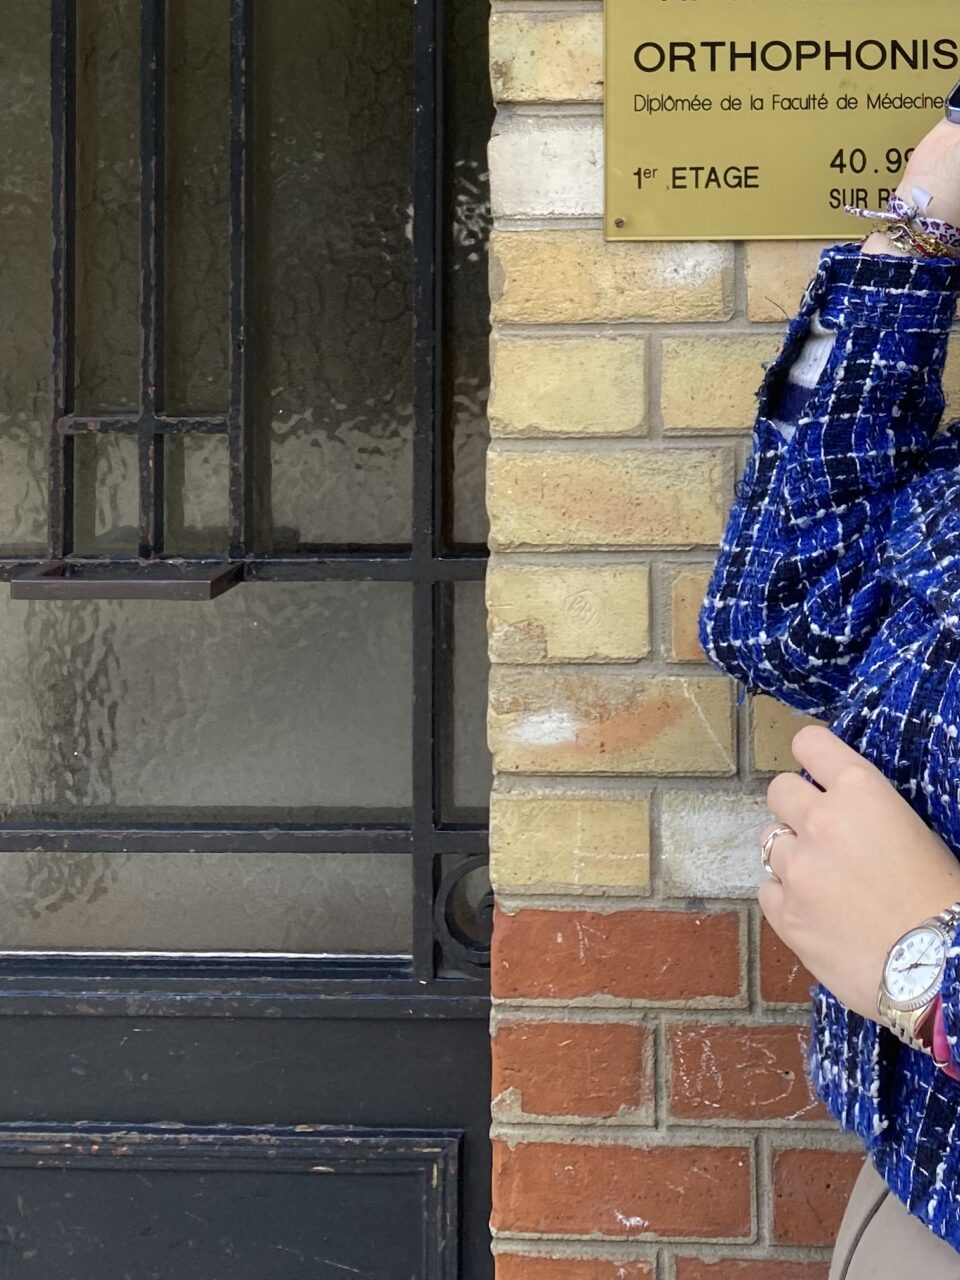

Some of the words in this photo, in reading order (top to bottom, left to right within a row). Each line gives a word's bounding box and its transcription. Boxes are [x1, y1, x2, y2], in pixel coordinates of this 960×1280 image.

[634, 93, 713, 115] Diplômée
[720, 94, 743, 111] de
[750, 94, 764, 111] la
[772, 93, 829, 111] Faculté
[836, 94, 859, 111] de
[866, 92, 945, 111] Médecine
[672, 166, 760, 189] ETAGE
[829, 188, 868, 210] SUR
